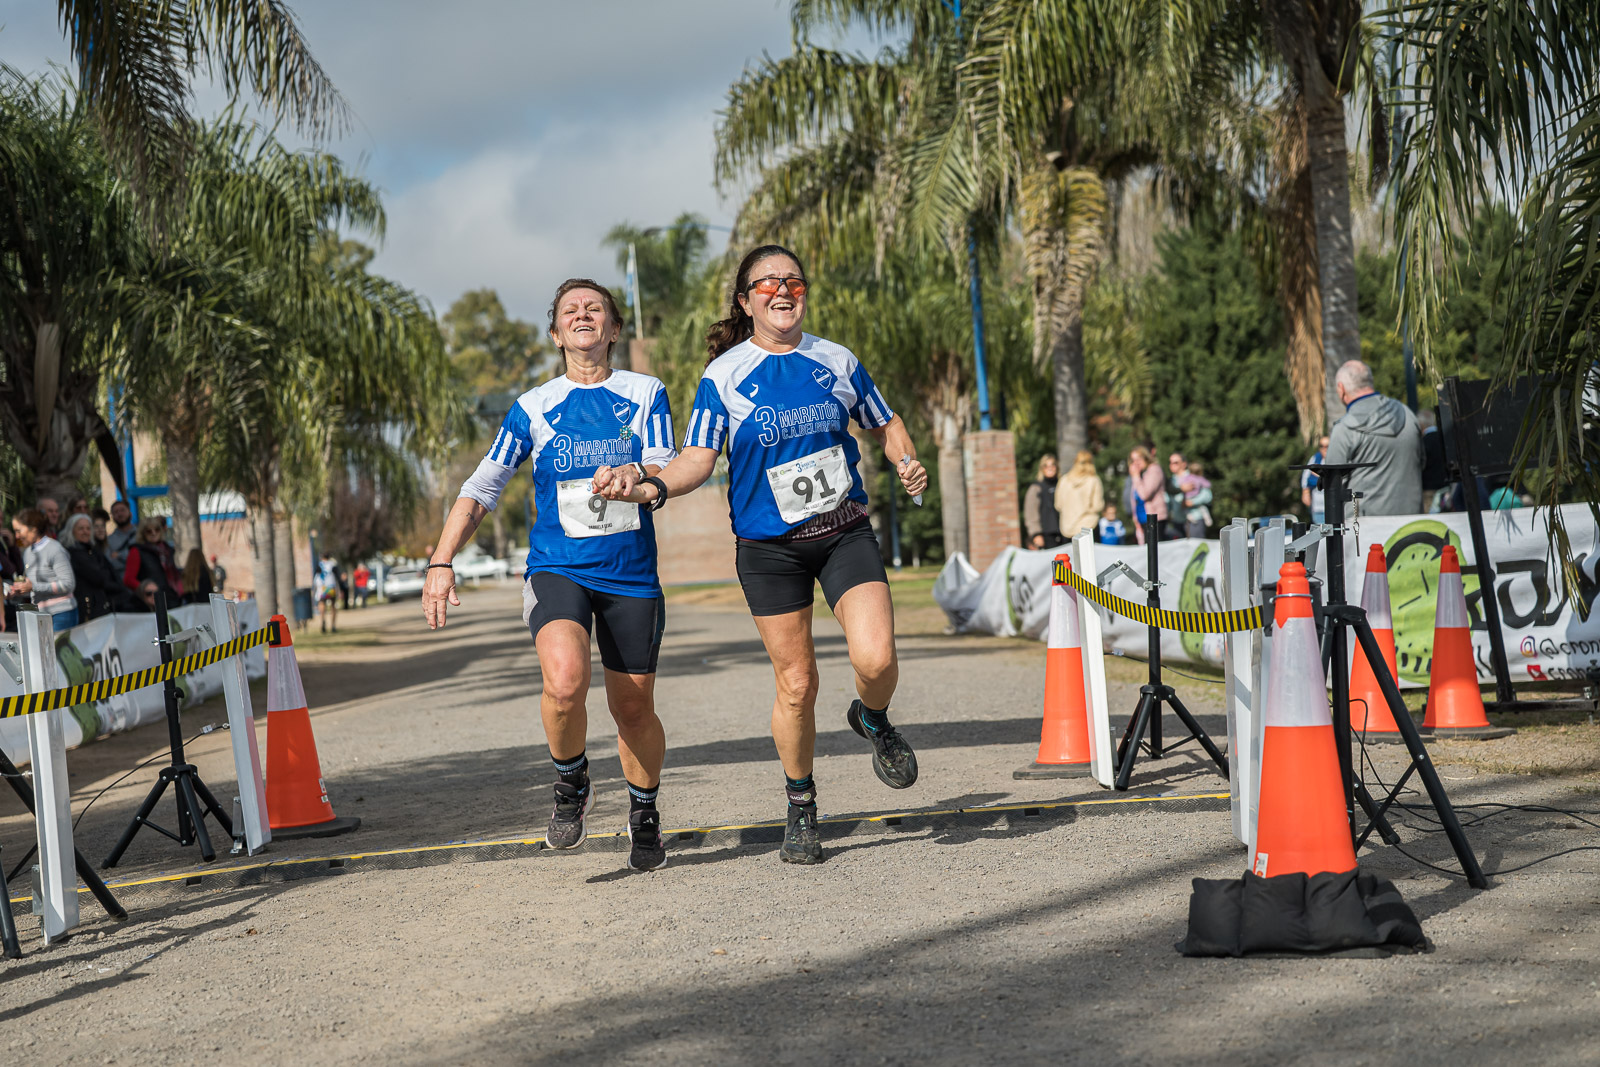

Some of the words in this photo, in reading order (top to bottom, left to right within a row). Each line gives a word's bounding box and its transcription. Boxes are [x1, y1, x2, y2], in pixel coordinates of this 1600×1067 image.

[755, 405, 780, 447] 3
[553, 434, 572, 473] 3
[792, 468, 837, 504] 91
[588, 494, 608, 522] 9
[1540, 637, 1600, 660] @cron
